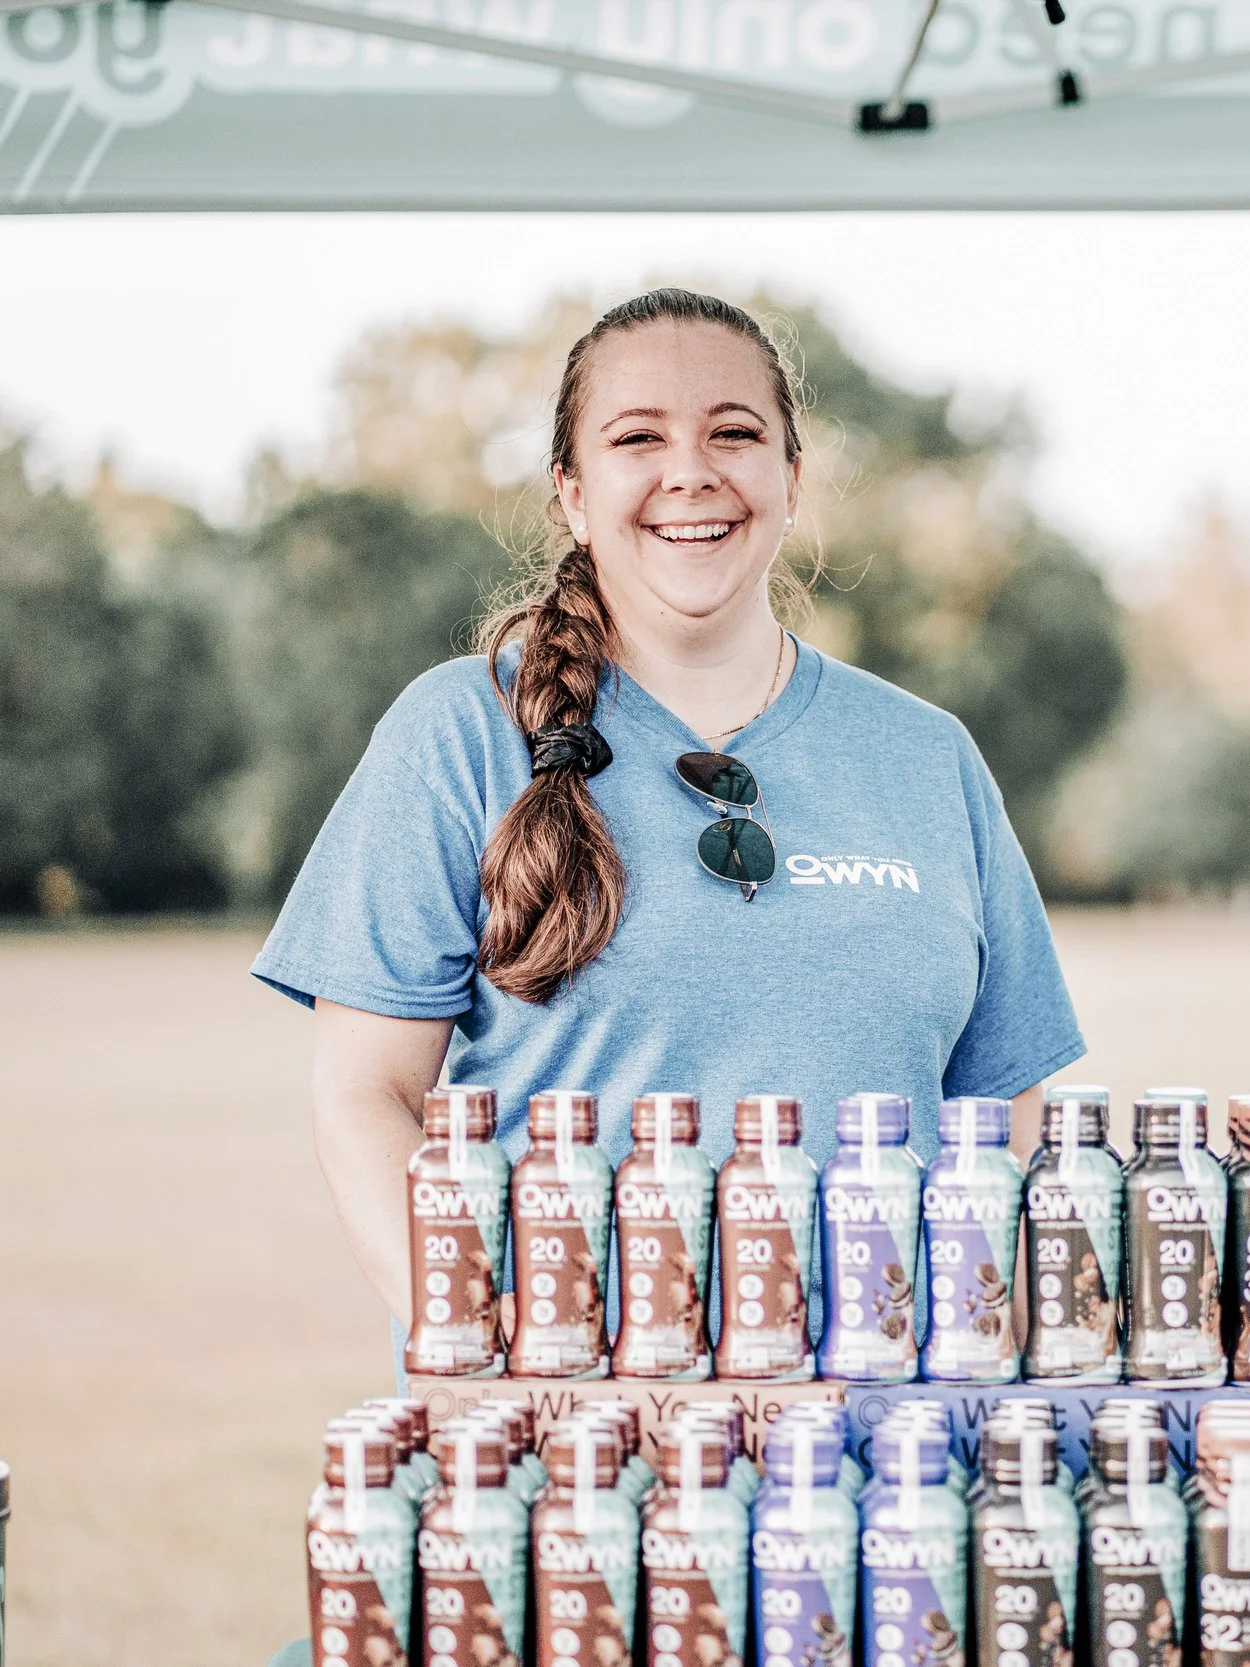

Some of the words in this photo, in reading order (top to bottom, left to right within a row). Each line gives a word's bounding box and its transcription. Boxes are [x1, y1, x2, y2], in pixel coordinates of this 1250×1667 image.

[785, 855, 920, 893] OWYN
[413, 1182, 499, 1217] OWYN
[518, 1184, 601, 1218] OWYN
[618, 1183, 701, 1218] OWYN
[725, 1185, 807, 1221] OWYN
[826, 1187, 912, 1222] OWYN
[924, 1186, 1009, 1221] OWYN
[1028, 1185, 1112, 1220] OWYN
[1147, 1186, 1226, 1222] OWYN
